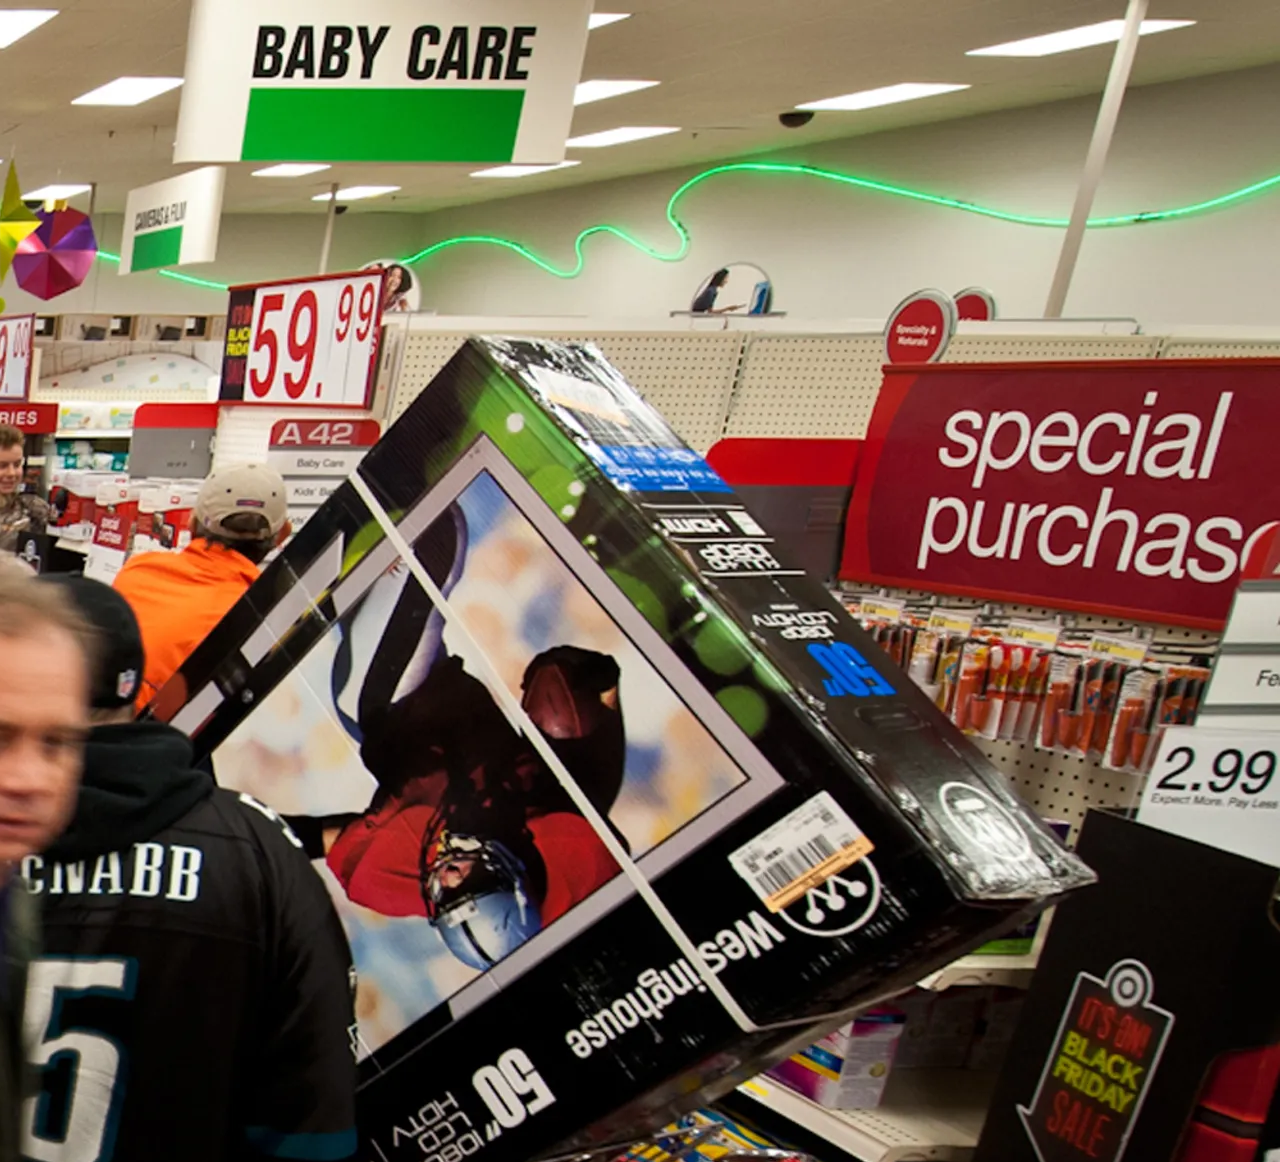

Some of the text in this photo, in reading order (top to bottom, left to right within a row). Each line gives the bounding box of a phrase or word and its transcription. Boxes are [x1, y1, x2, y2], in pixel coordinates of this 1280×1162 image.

[251, 24, 538, 81] BABY CARE
[134, 207, 165, 231] CAMERAS
[277, 422, 354, 445] A 42
[939, 391, 1233, 489] special
[296, 458, 345, 469] Baby Care
[1156, 746, 1278, 795] 2.99
[1151, 792, 1191, 805] Expect
[1227, 796, 1248, 809] Pay
[1251, 798, 1279, 810] Less
[565, 910, 787, 1059] Wesinghouse
[1052, 1055, 1137, 1114] FRIDAY
[1062, 1029, 1145, 1091] BLACK
[392, 1090, 460, 1147] HDTV
[416, 1110, 474, 1153] LCD
[1046, 1090, 1113, 1158] SALE
